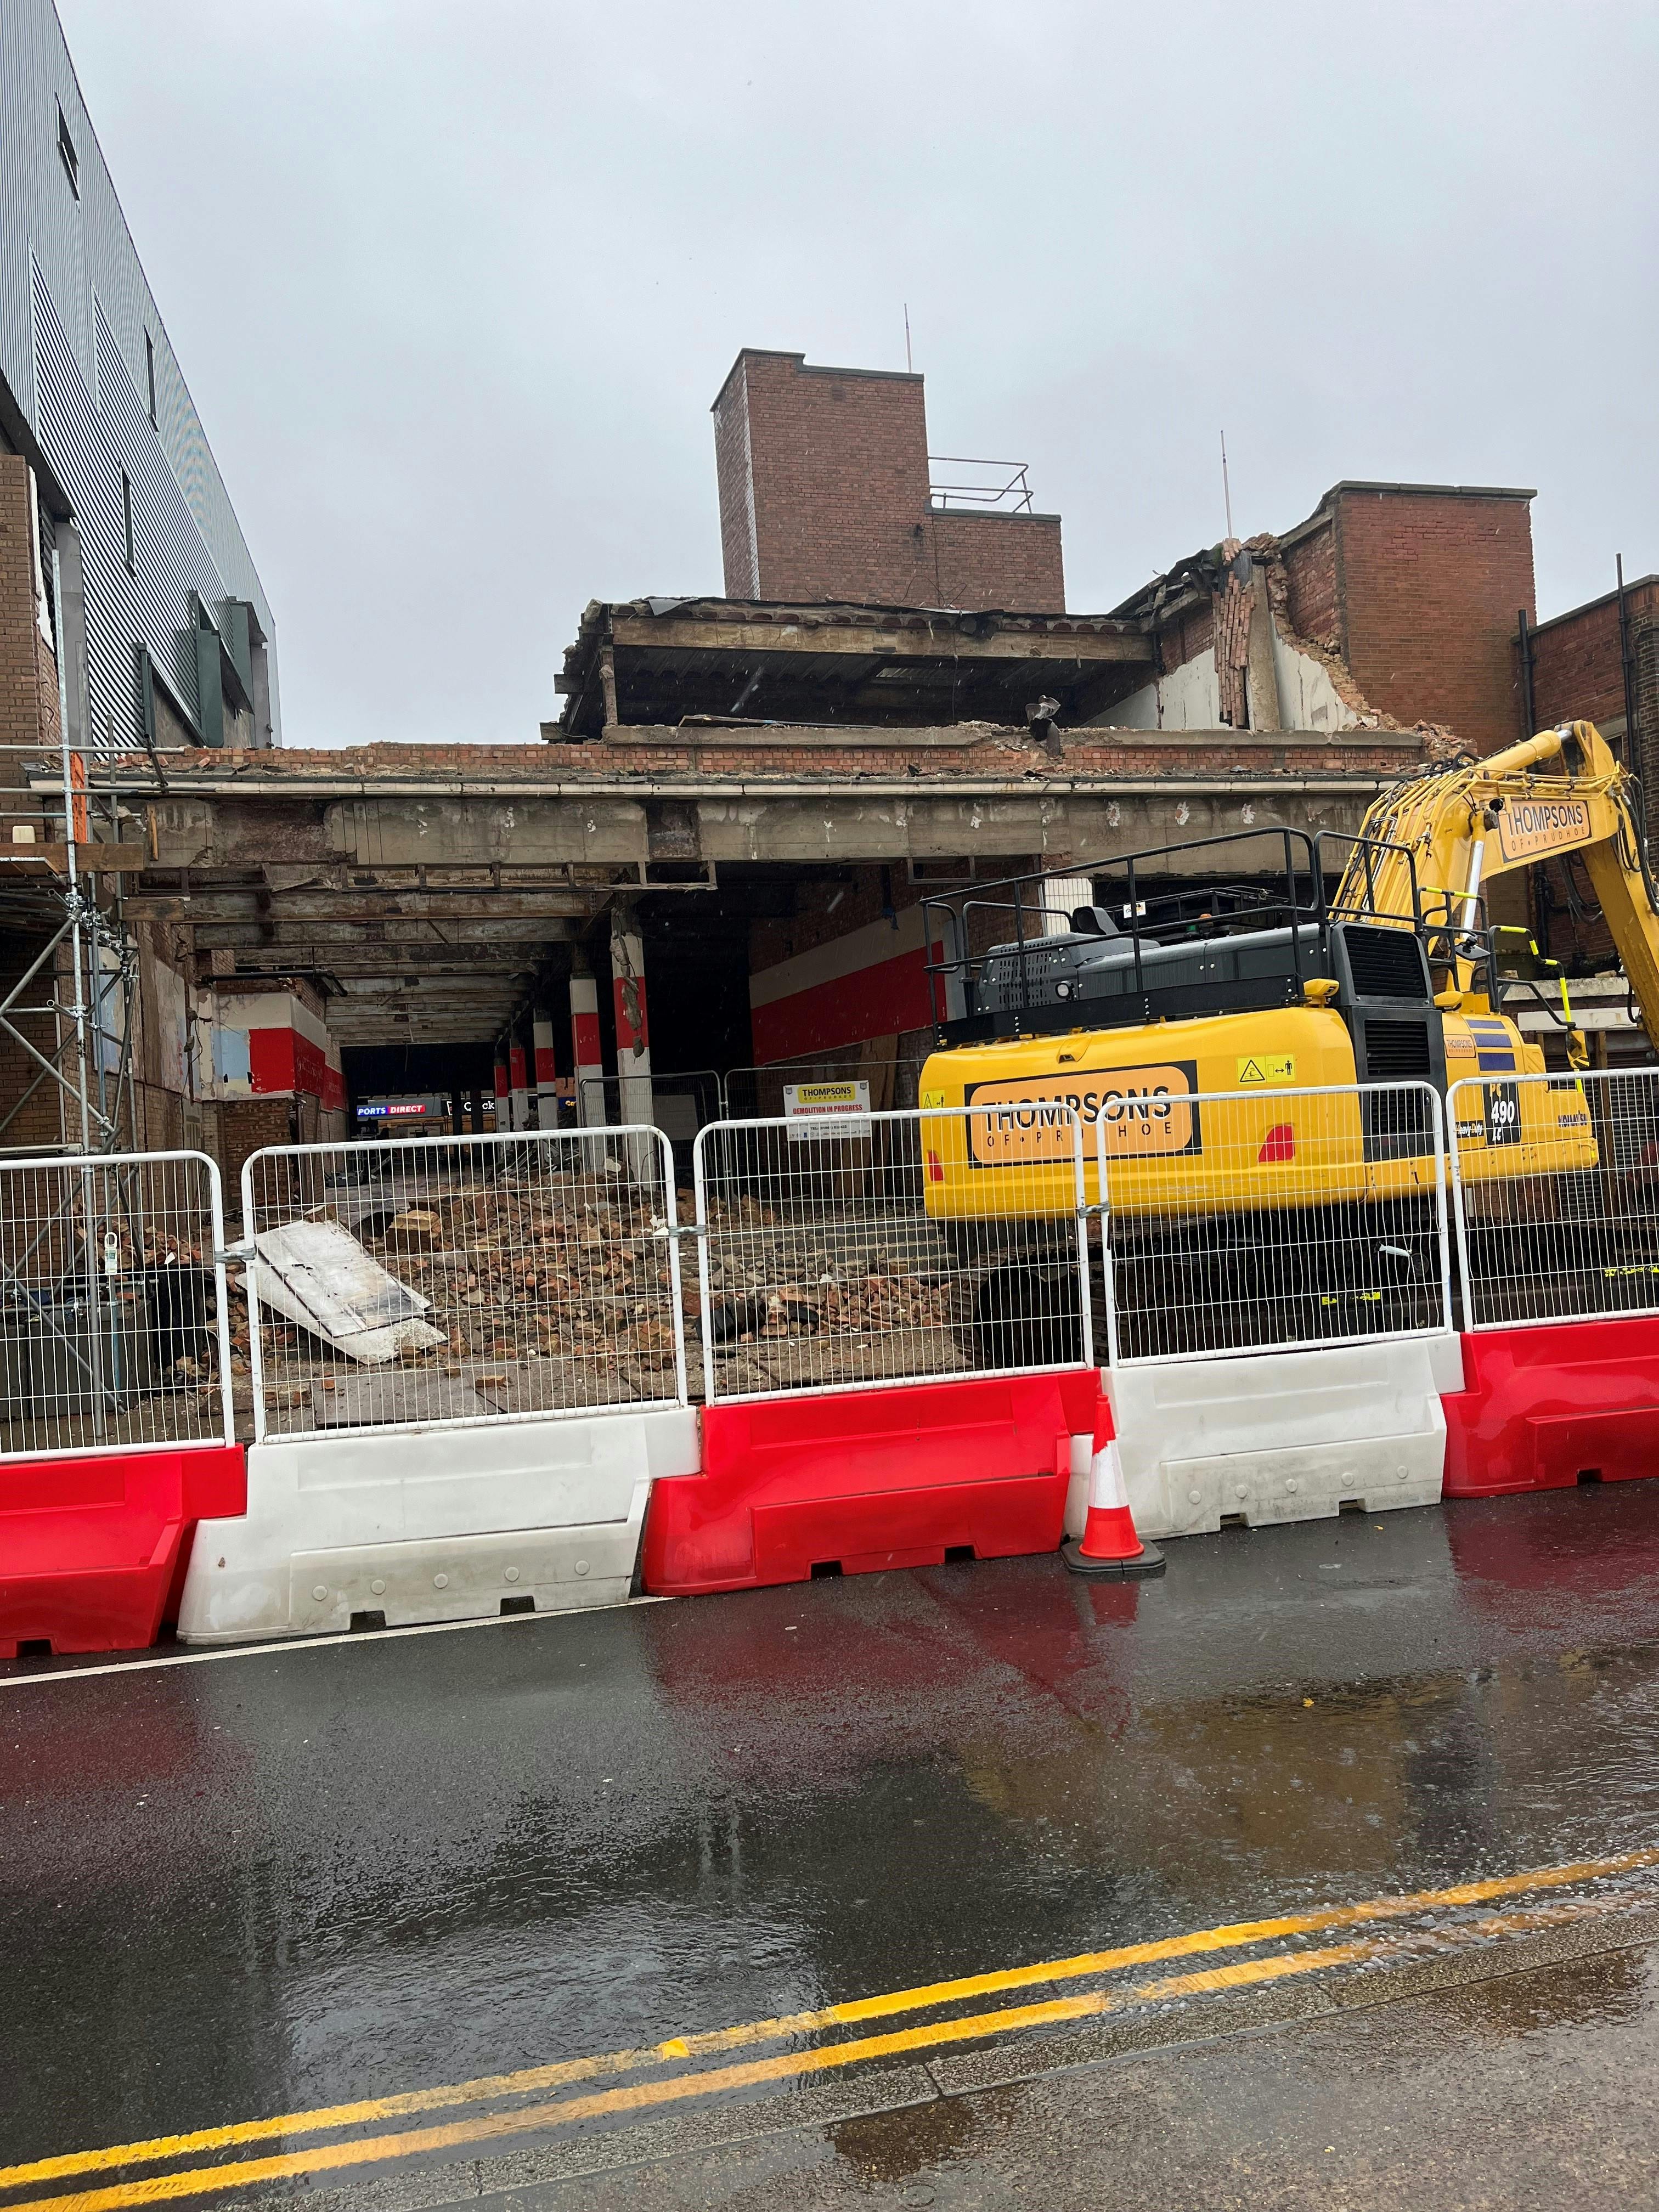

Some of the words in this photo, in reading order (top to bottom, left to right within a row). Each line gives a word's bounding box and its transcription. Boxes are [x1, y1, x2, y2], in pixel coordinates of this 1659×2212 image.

[803, 1086, 851, 1097] THOMPSONS
[1489, 1083, 1502, 1097] PC
[357, 1107, 386, 1115] PORTS
[390, 1104, 423, 1114] DIRECT
[793, 1106, 826, 1115] DEMOLITION
[834, 1104, 863, 1113] PROGRESS
[981, 1085, 1172, 1133] THOMPSONS
[1491, 1101, 1515, 1124] 490
